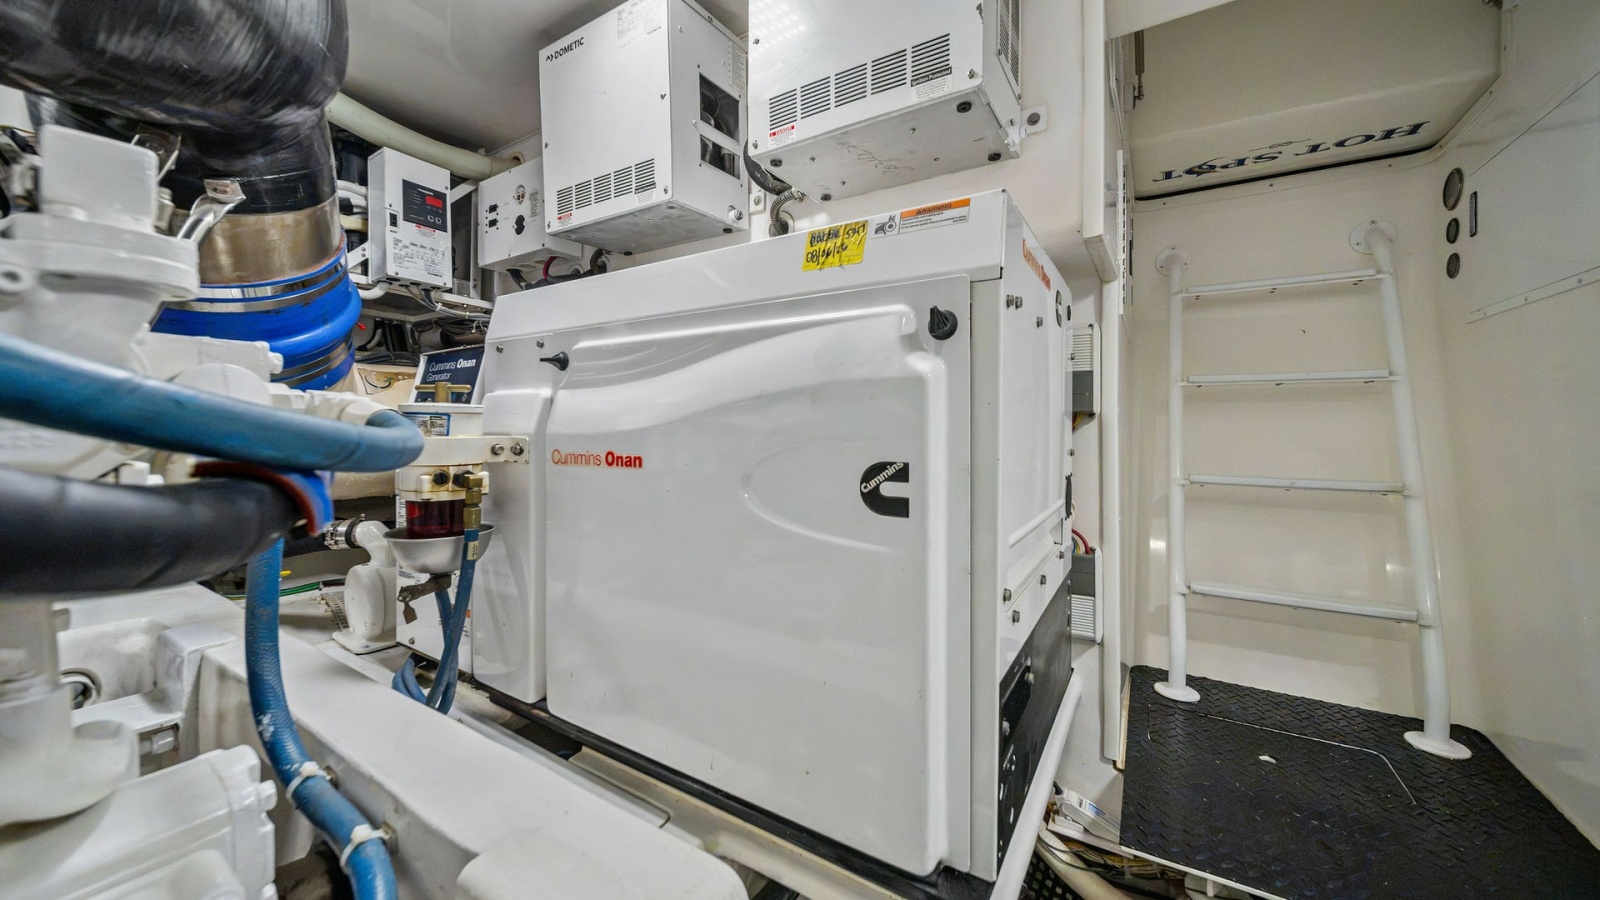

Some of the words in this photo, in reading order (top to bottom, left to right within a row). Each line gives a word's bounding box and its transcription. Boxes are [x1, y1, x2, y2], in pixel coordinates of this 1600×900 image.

[554, 36, 584, 60] DOMETIC
[1293, 120, 1431, 156] HOT
[1151, 151, 1283, 182] SPOT
[920, 202, 952, 214] WARNING
[429, 361, 457, 372] Cummins
[456, 358, 477, 369] Onan
[426, 372, 452, 382] Generator
[551, 448, 602, 467] Cummins
[604, 450, 643, 468] Onan
[861, 462, 904, 493] Cummins
